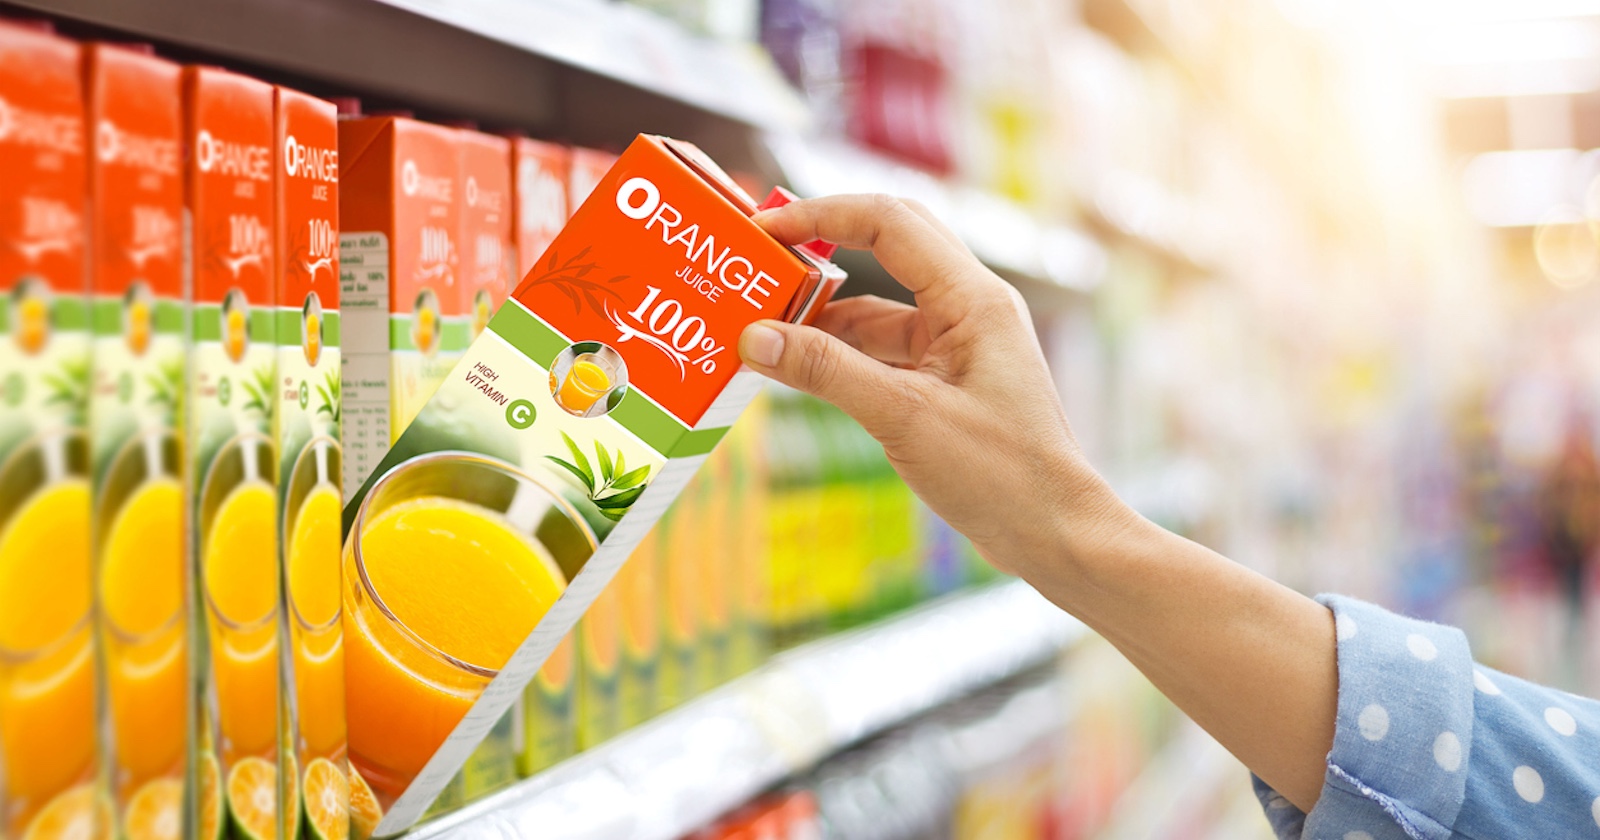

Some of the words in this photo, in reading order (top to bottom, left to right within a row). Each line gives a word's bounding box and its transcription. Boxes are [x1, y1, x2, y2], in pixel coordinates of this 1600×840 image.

[196, 129, 270, 182] ORANGE
[285, 135, 338, 182] ORANGE
[616, 177, 780, 310] ORANGE
[675, 265, 714, 303] JUICE
[627, 285, 725, 374] 100%
[465, 370, 509, 406] VITAMIN
[473, 361, 500, 382] HIGH
